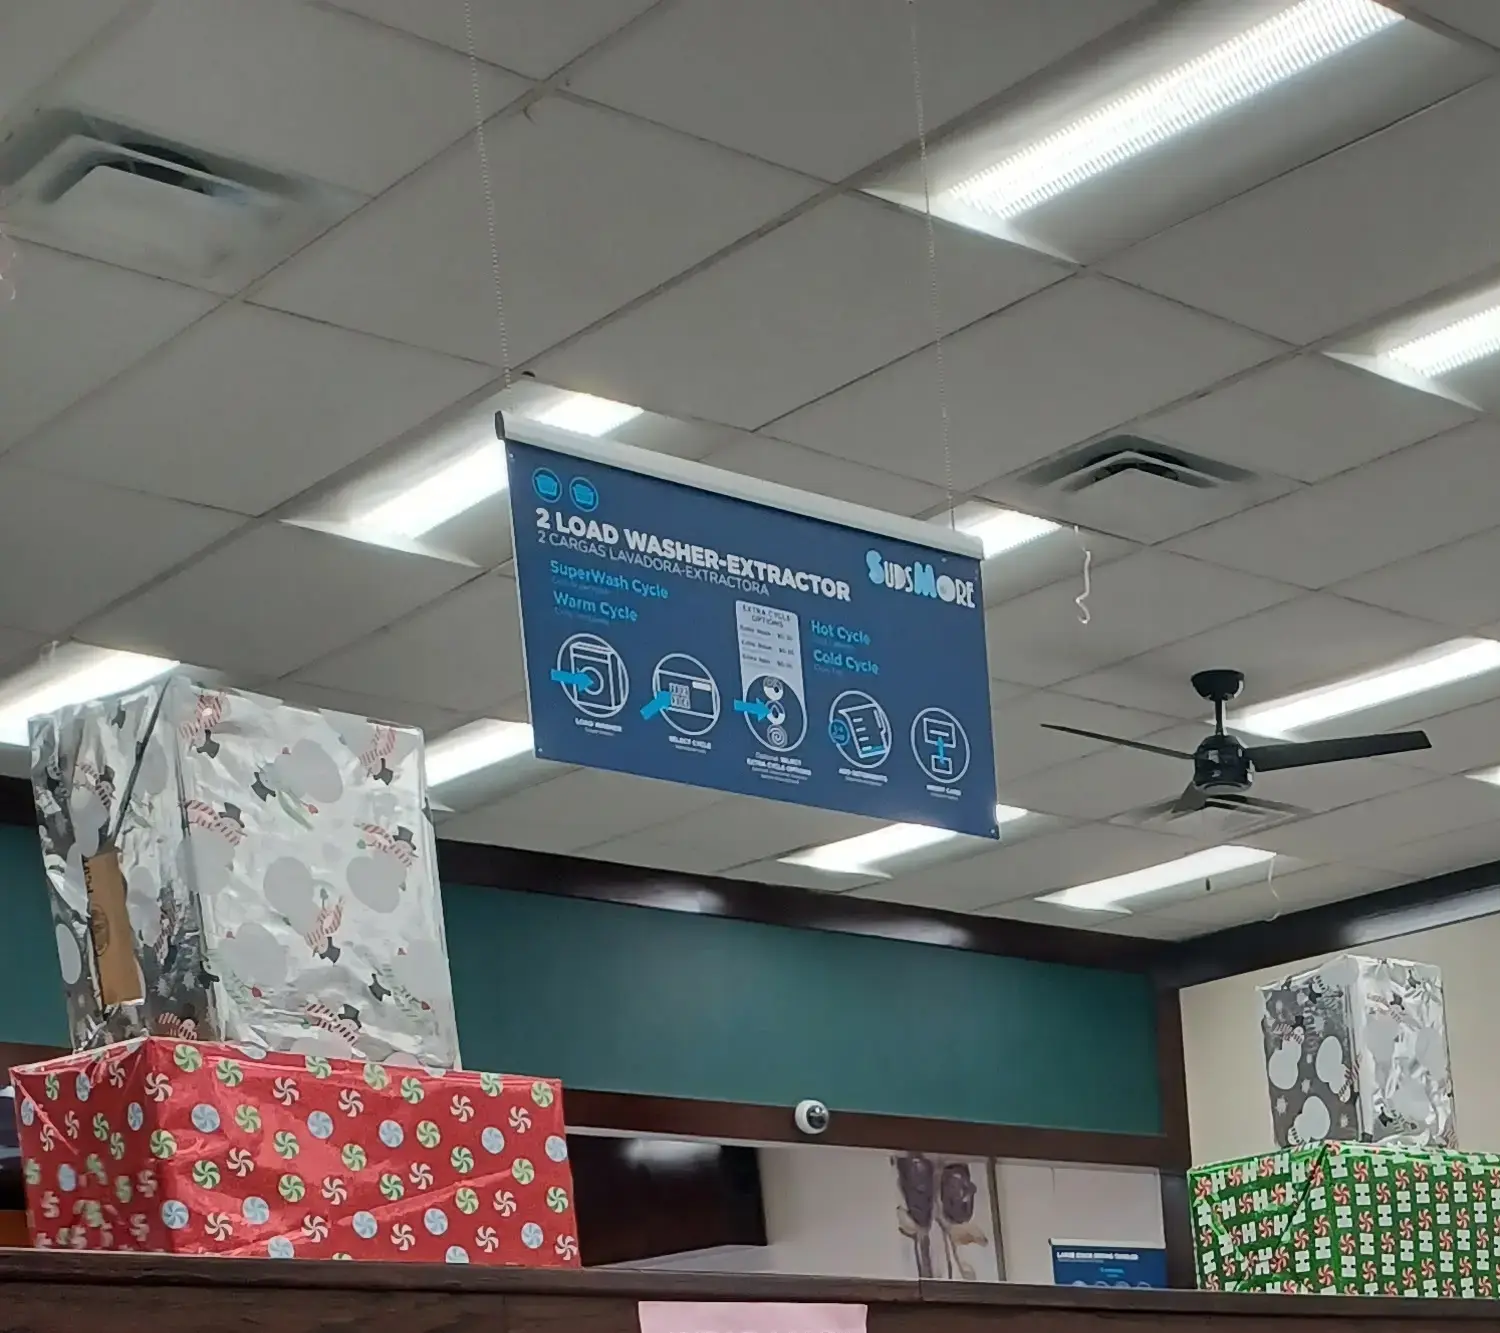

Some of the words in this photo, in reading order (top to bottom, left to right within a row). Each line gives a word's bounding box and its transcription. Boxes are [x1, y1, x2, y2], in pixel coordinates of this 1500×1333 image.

[535, 507, 551, 530] 2
[555, 511, 619, 545] LOAD
[623, 528, 851, 602] WASHER-EXTRACTOR
[537, 530, 546, 544] 2
[549, 532, 606, 558] CARGAS
[609, 548, 770, 597] LAVADORA-EXTRACTORA
[550, 560, 629, 591] SuperWash
[632, 579, 669, 600] Cycle
[553, 590, 596, 612] Warm
[600, 601, 638, 622] Cycle
[811, 619, 834, 637] Hot
[837, 626, 871, 646] Cycle
[813, 649, 842, 667] Cold
[845, 656, 879, 676] Cycle
